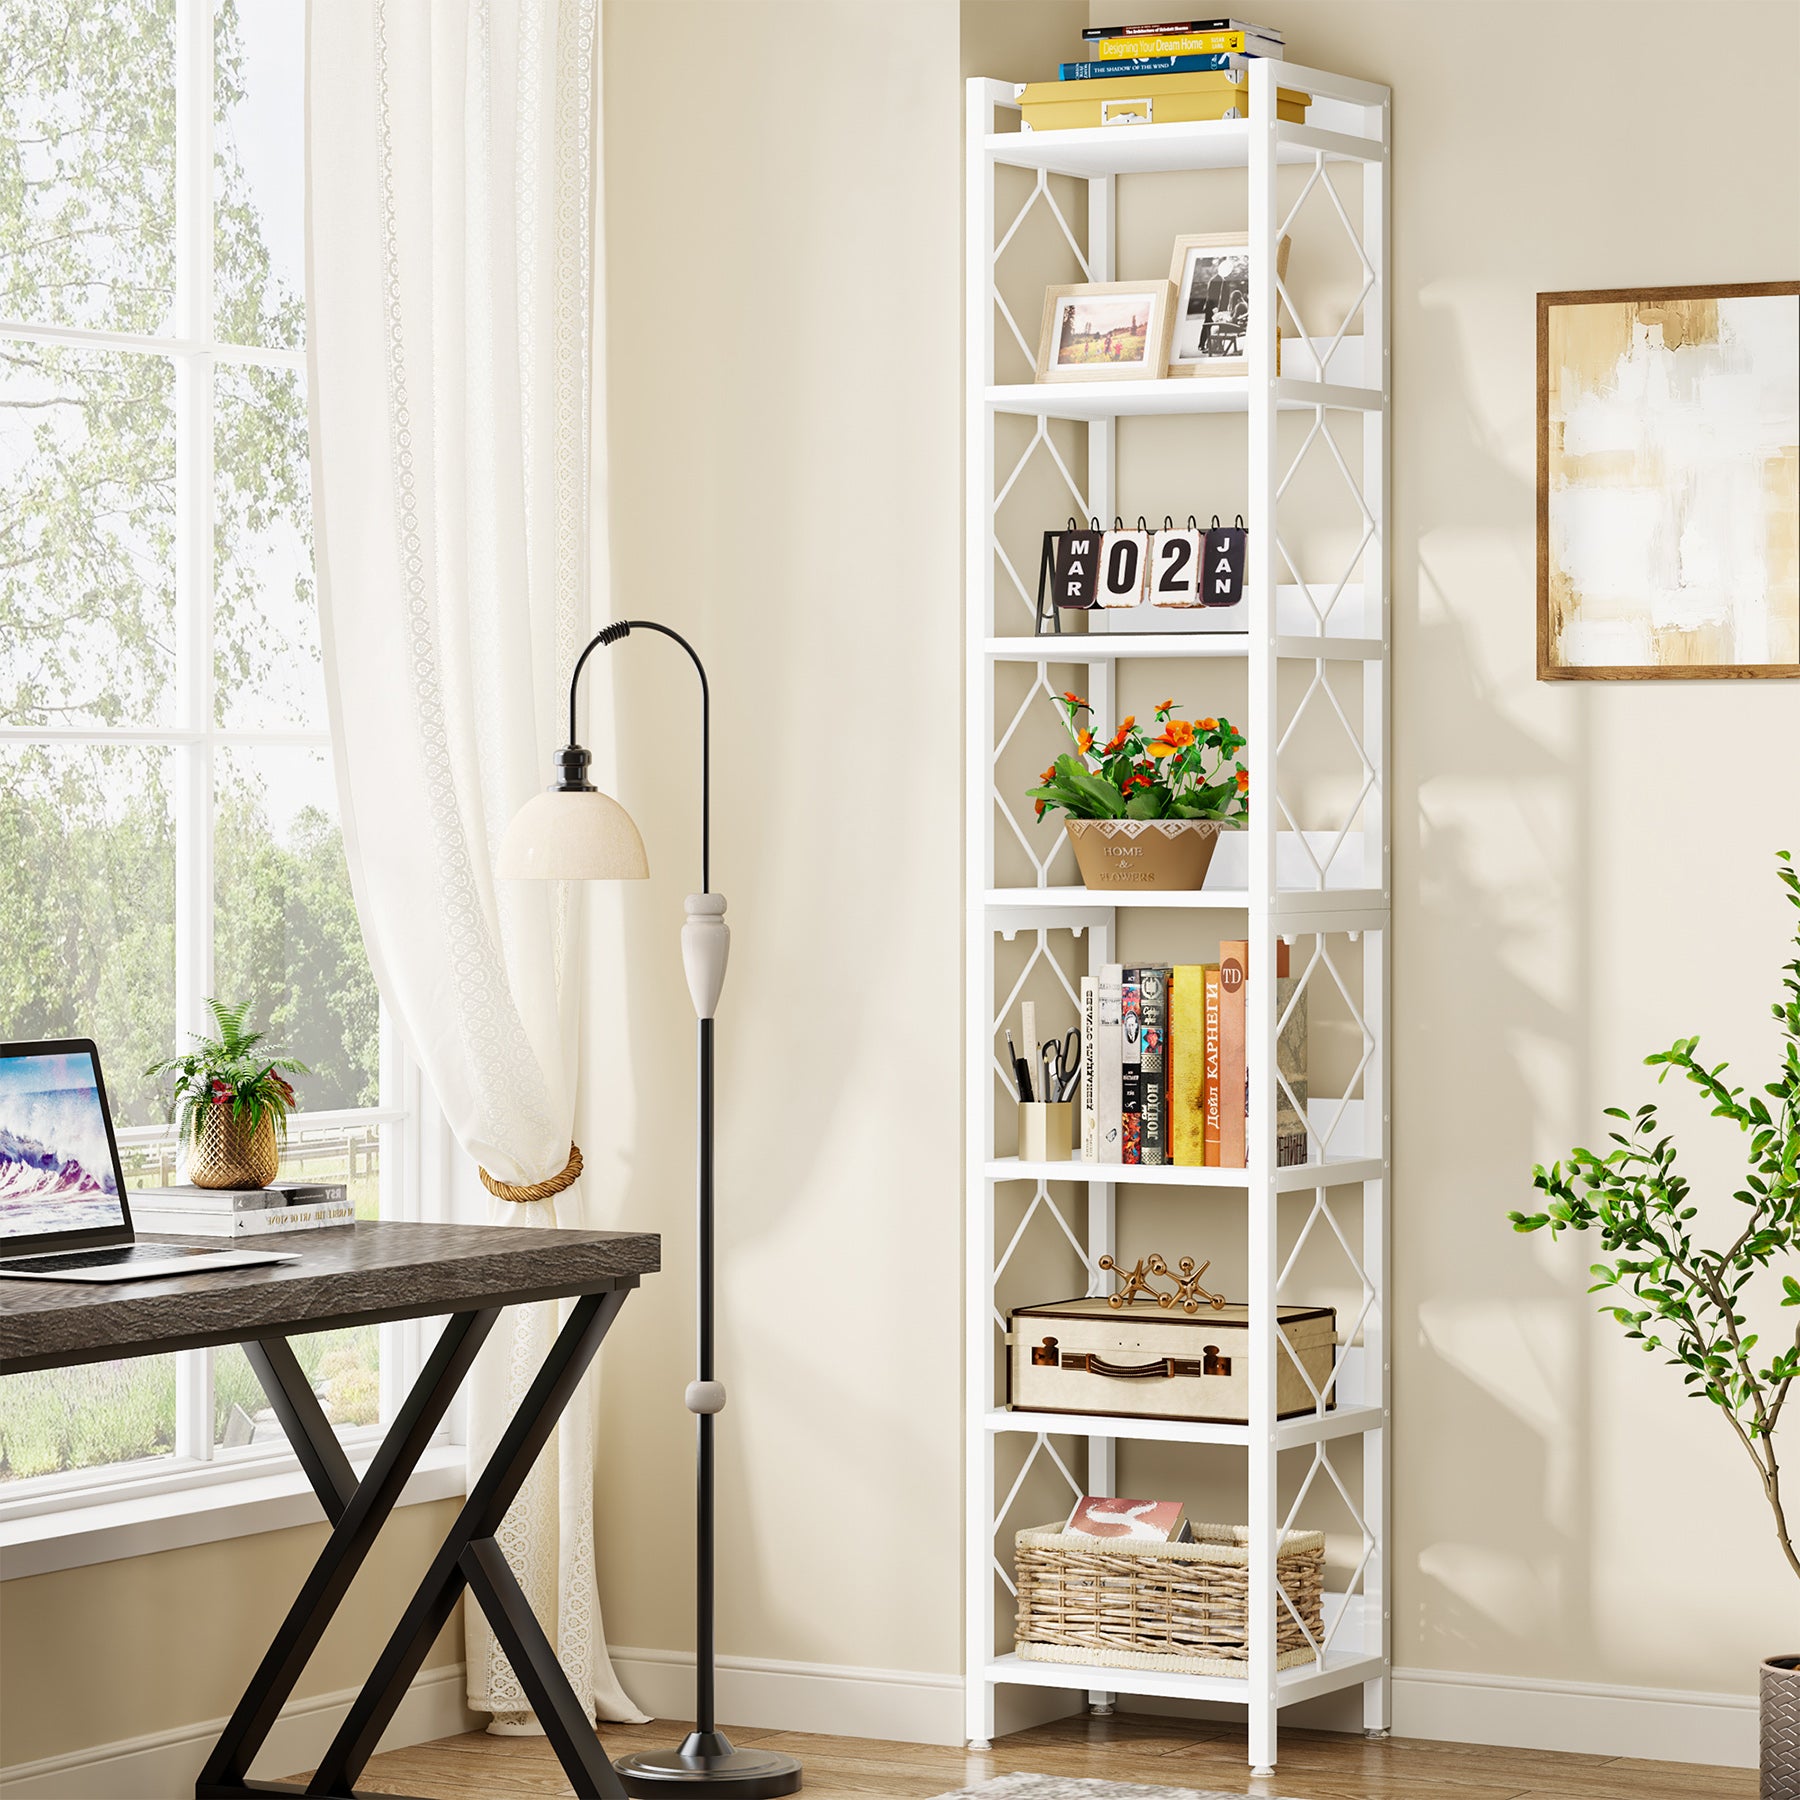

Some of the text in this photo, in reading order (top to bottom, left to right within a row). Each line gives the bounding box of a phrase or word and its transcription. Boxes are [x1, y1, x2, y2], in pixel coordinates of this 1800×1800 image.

[1103, 38, 1203, 56] Designing Your Dream Home
[1067, 540, 1090, 596] MAR
[1215, 538, 1232, 594] JAN
[1104, 847, 1144, 857] HOME
[1100, 872, 1155, 882] FLOWERS
[1222, 968, 1242, 984] TD
[1208, 982, 1220, 1130] Дейл КАРНЕГИ
